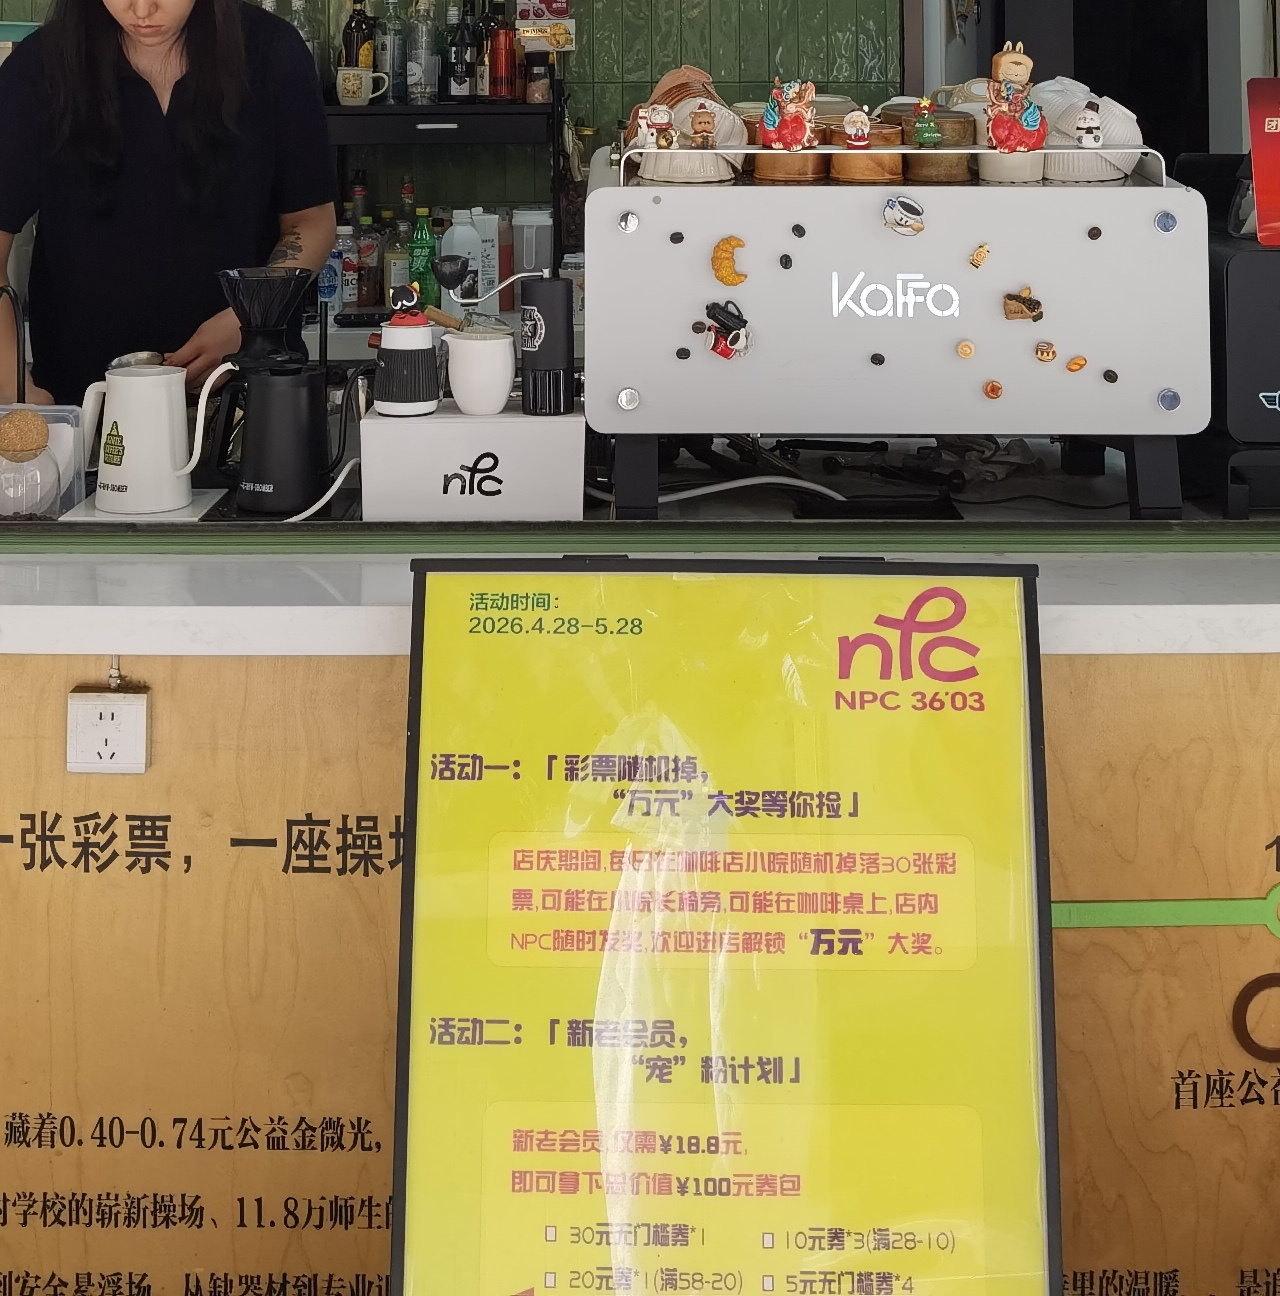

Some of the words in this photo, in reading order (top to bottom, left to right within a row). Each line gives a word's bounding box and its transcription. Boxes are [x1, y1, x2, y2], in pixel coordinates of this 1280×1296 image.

[469, 592, 560, 611] 活动时间：
[468, 617, 643, 636] 2026.4.28-5.28
[835, 691, 901, 711] NPC
